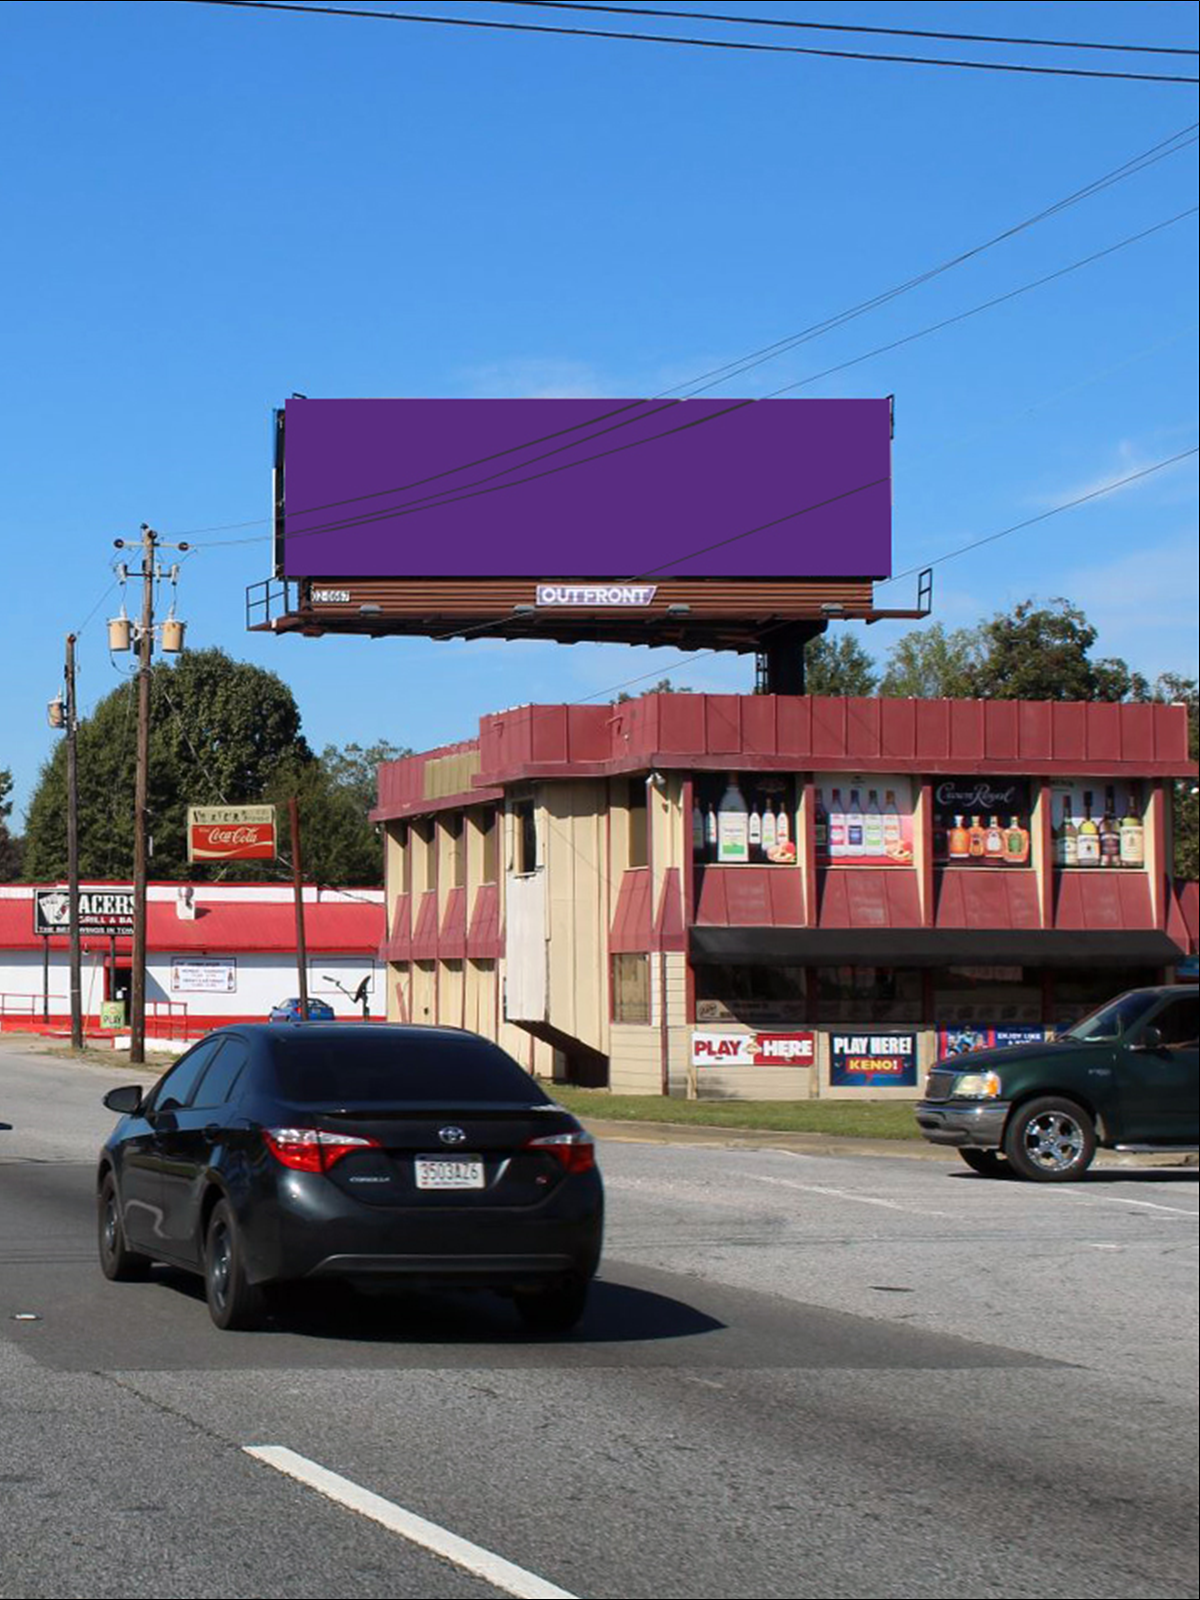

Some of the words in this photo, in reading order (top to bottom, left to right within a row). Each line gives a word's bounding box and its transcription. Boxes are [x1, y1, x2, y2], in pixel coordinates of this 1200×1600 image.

[541, 587, 649, 603] OUTFRONT
[208, 826, 259, 845] Coca-Cola
[117, 927, 134, 935] TOW
[694, 1040, 742, 1056] PLAY
[763, 1040, 813, 1057] HERE
[833, 1037, 868, 1054] PLAY
[870, 1037, 912, 1055] HERE!
[849, 1059, 898, 1070] KENO!
